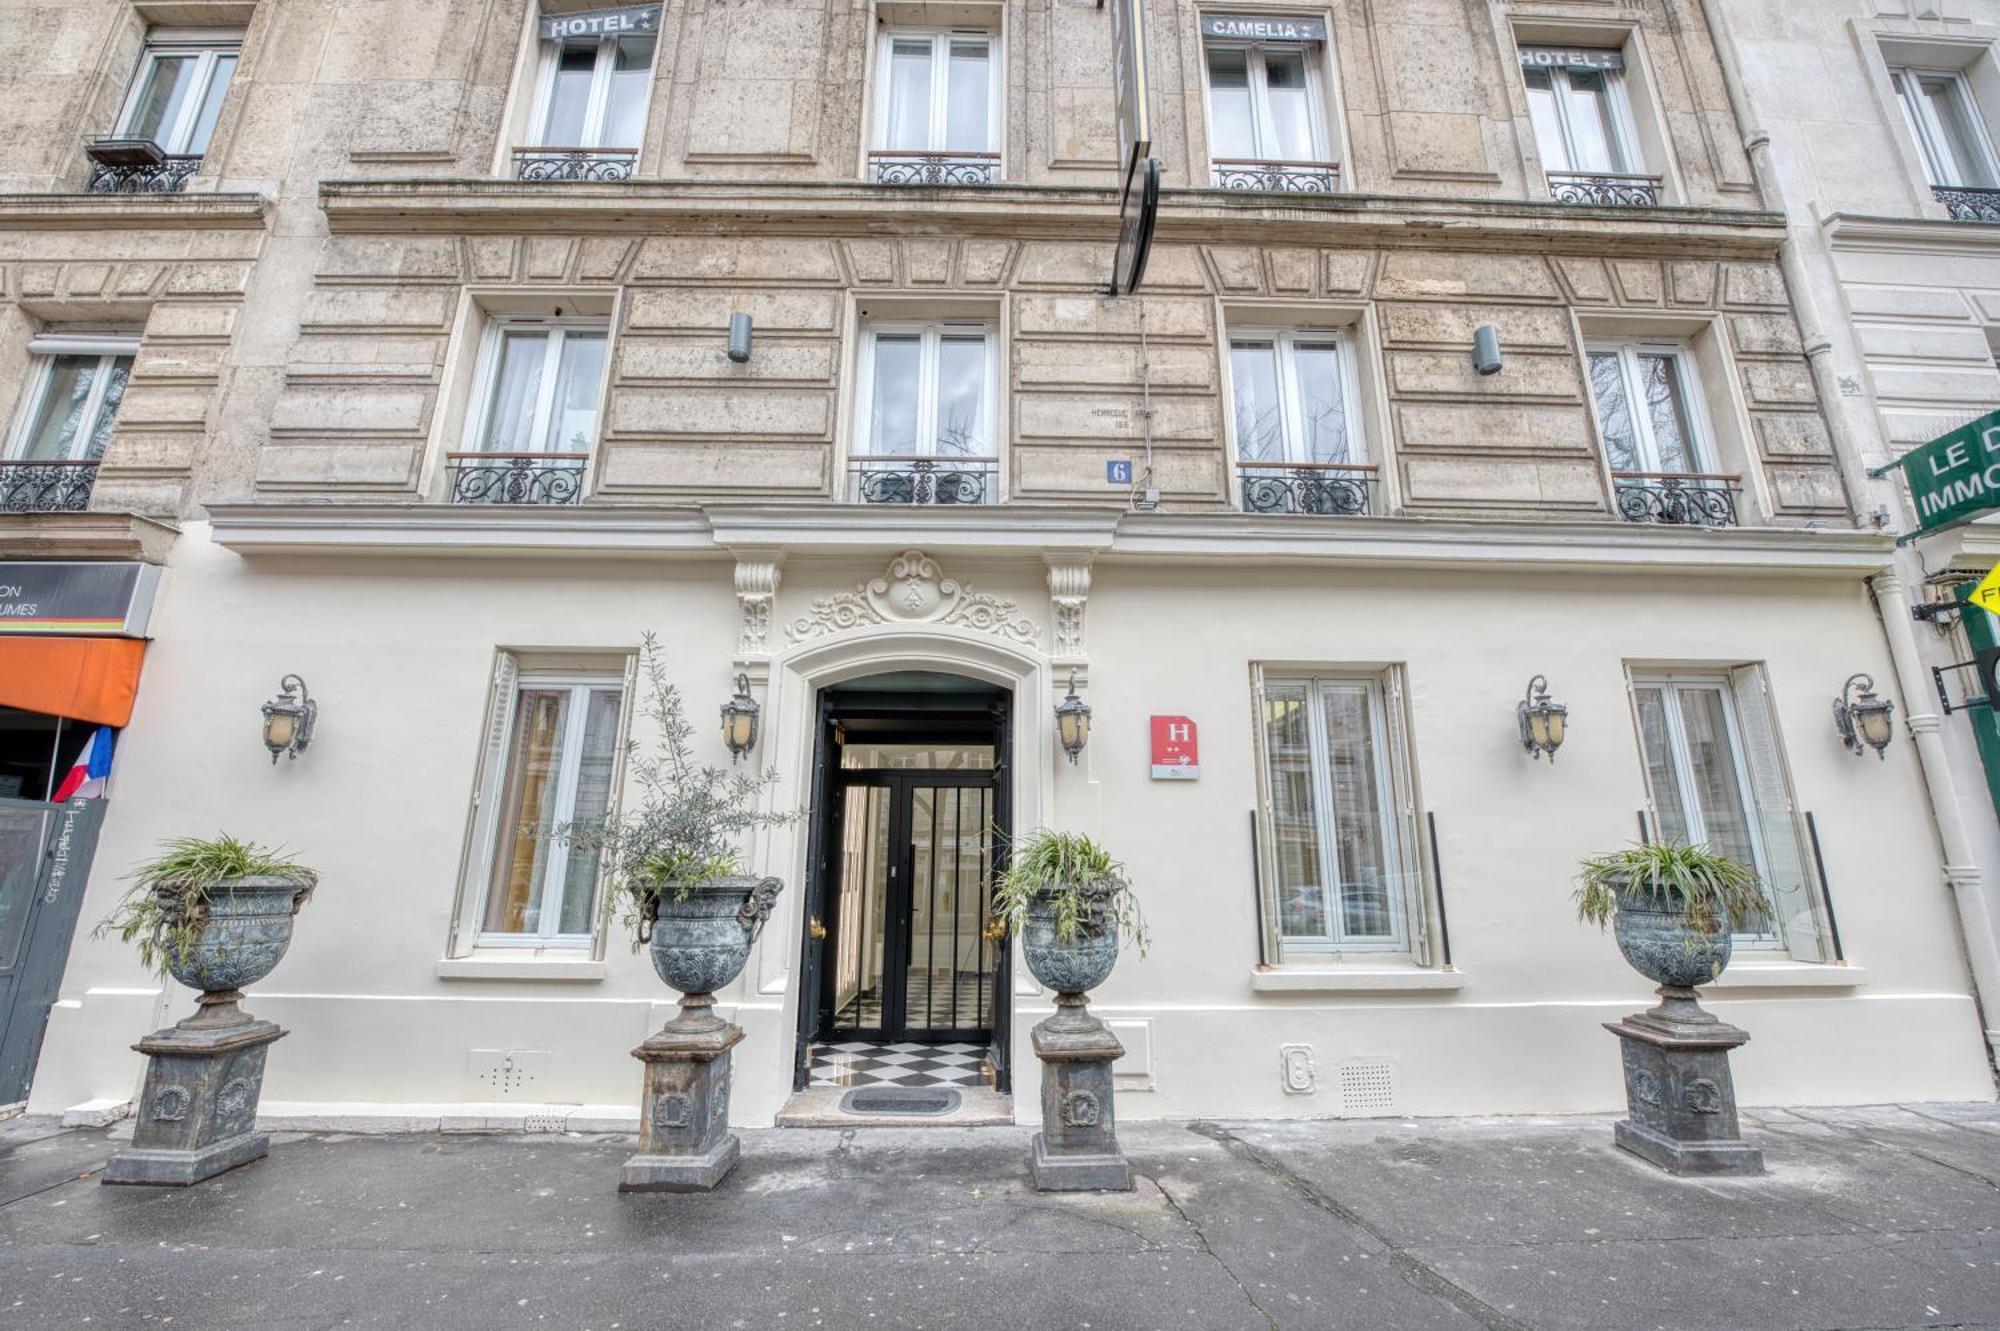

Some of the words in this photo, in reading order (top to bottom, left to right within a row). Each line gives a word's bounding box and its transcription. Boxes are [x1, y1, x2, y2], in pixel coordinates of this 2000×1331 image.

[551, 14, 635, 37] HOTEL
[1212, 20, 1298, 38] CAMELIA
[1519, 49, 1598, 67] HOTEL
[1929, 441, 1970, 476] LE
[1113, 463, 1126, 481] 6
[1168, 723, 1190, 742] H
